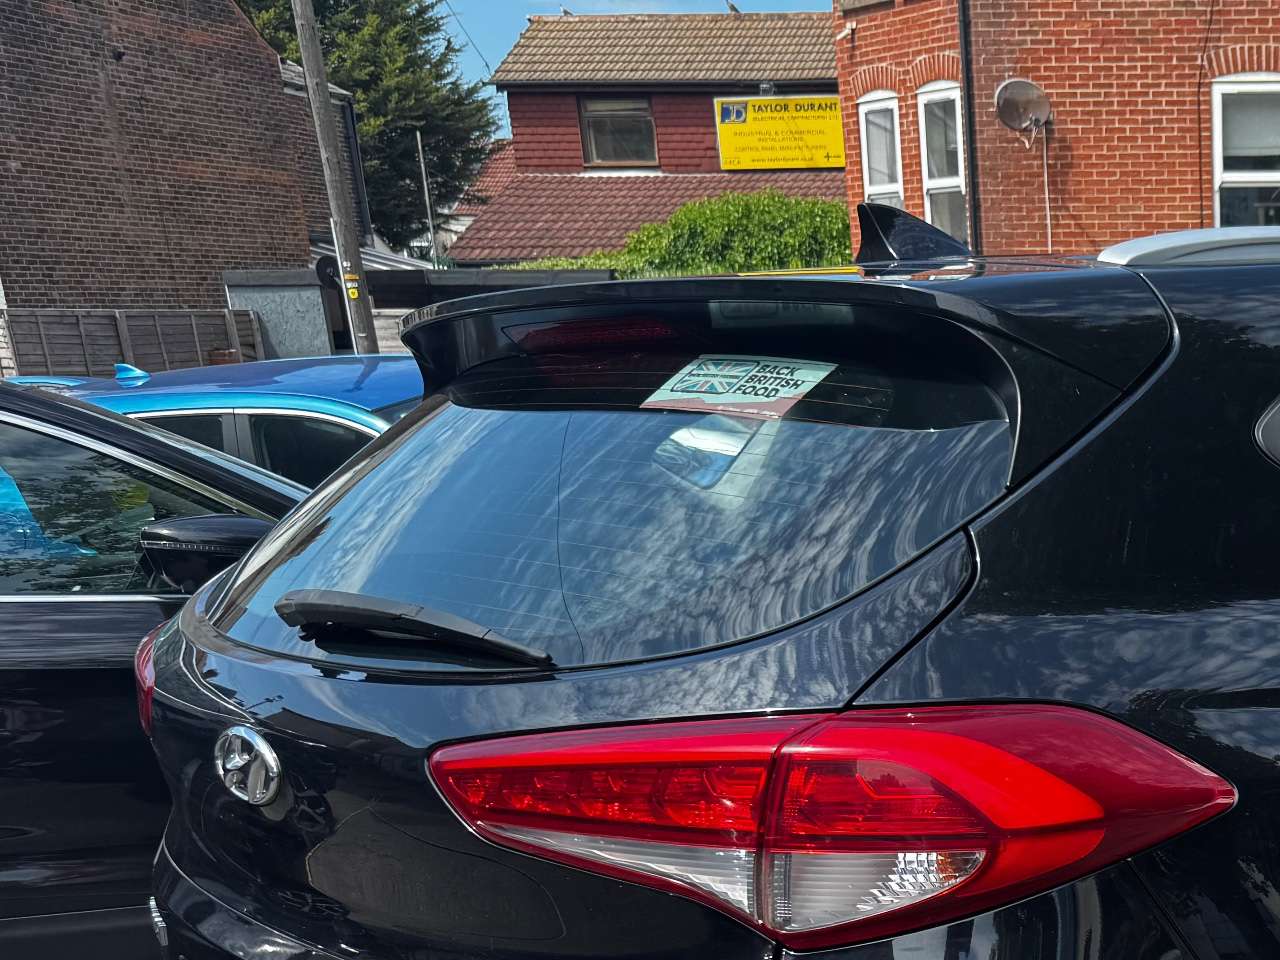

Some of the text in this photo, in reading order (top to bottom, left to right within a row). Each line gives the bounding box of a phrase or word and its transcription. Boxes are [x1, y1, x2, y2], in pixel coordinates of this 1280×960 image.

[752, 102, 838, 113] TAYLOR DURANT
[755, 364, 801, 377] BACK
[744, 374, 806, 389] BRITISH
[733, 384, 780, 398] FOOD
